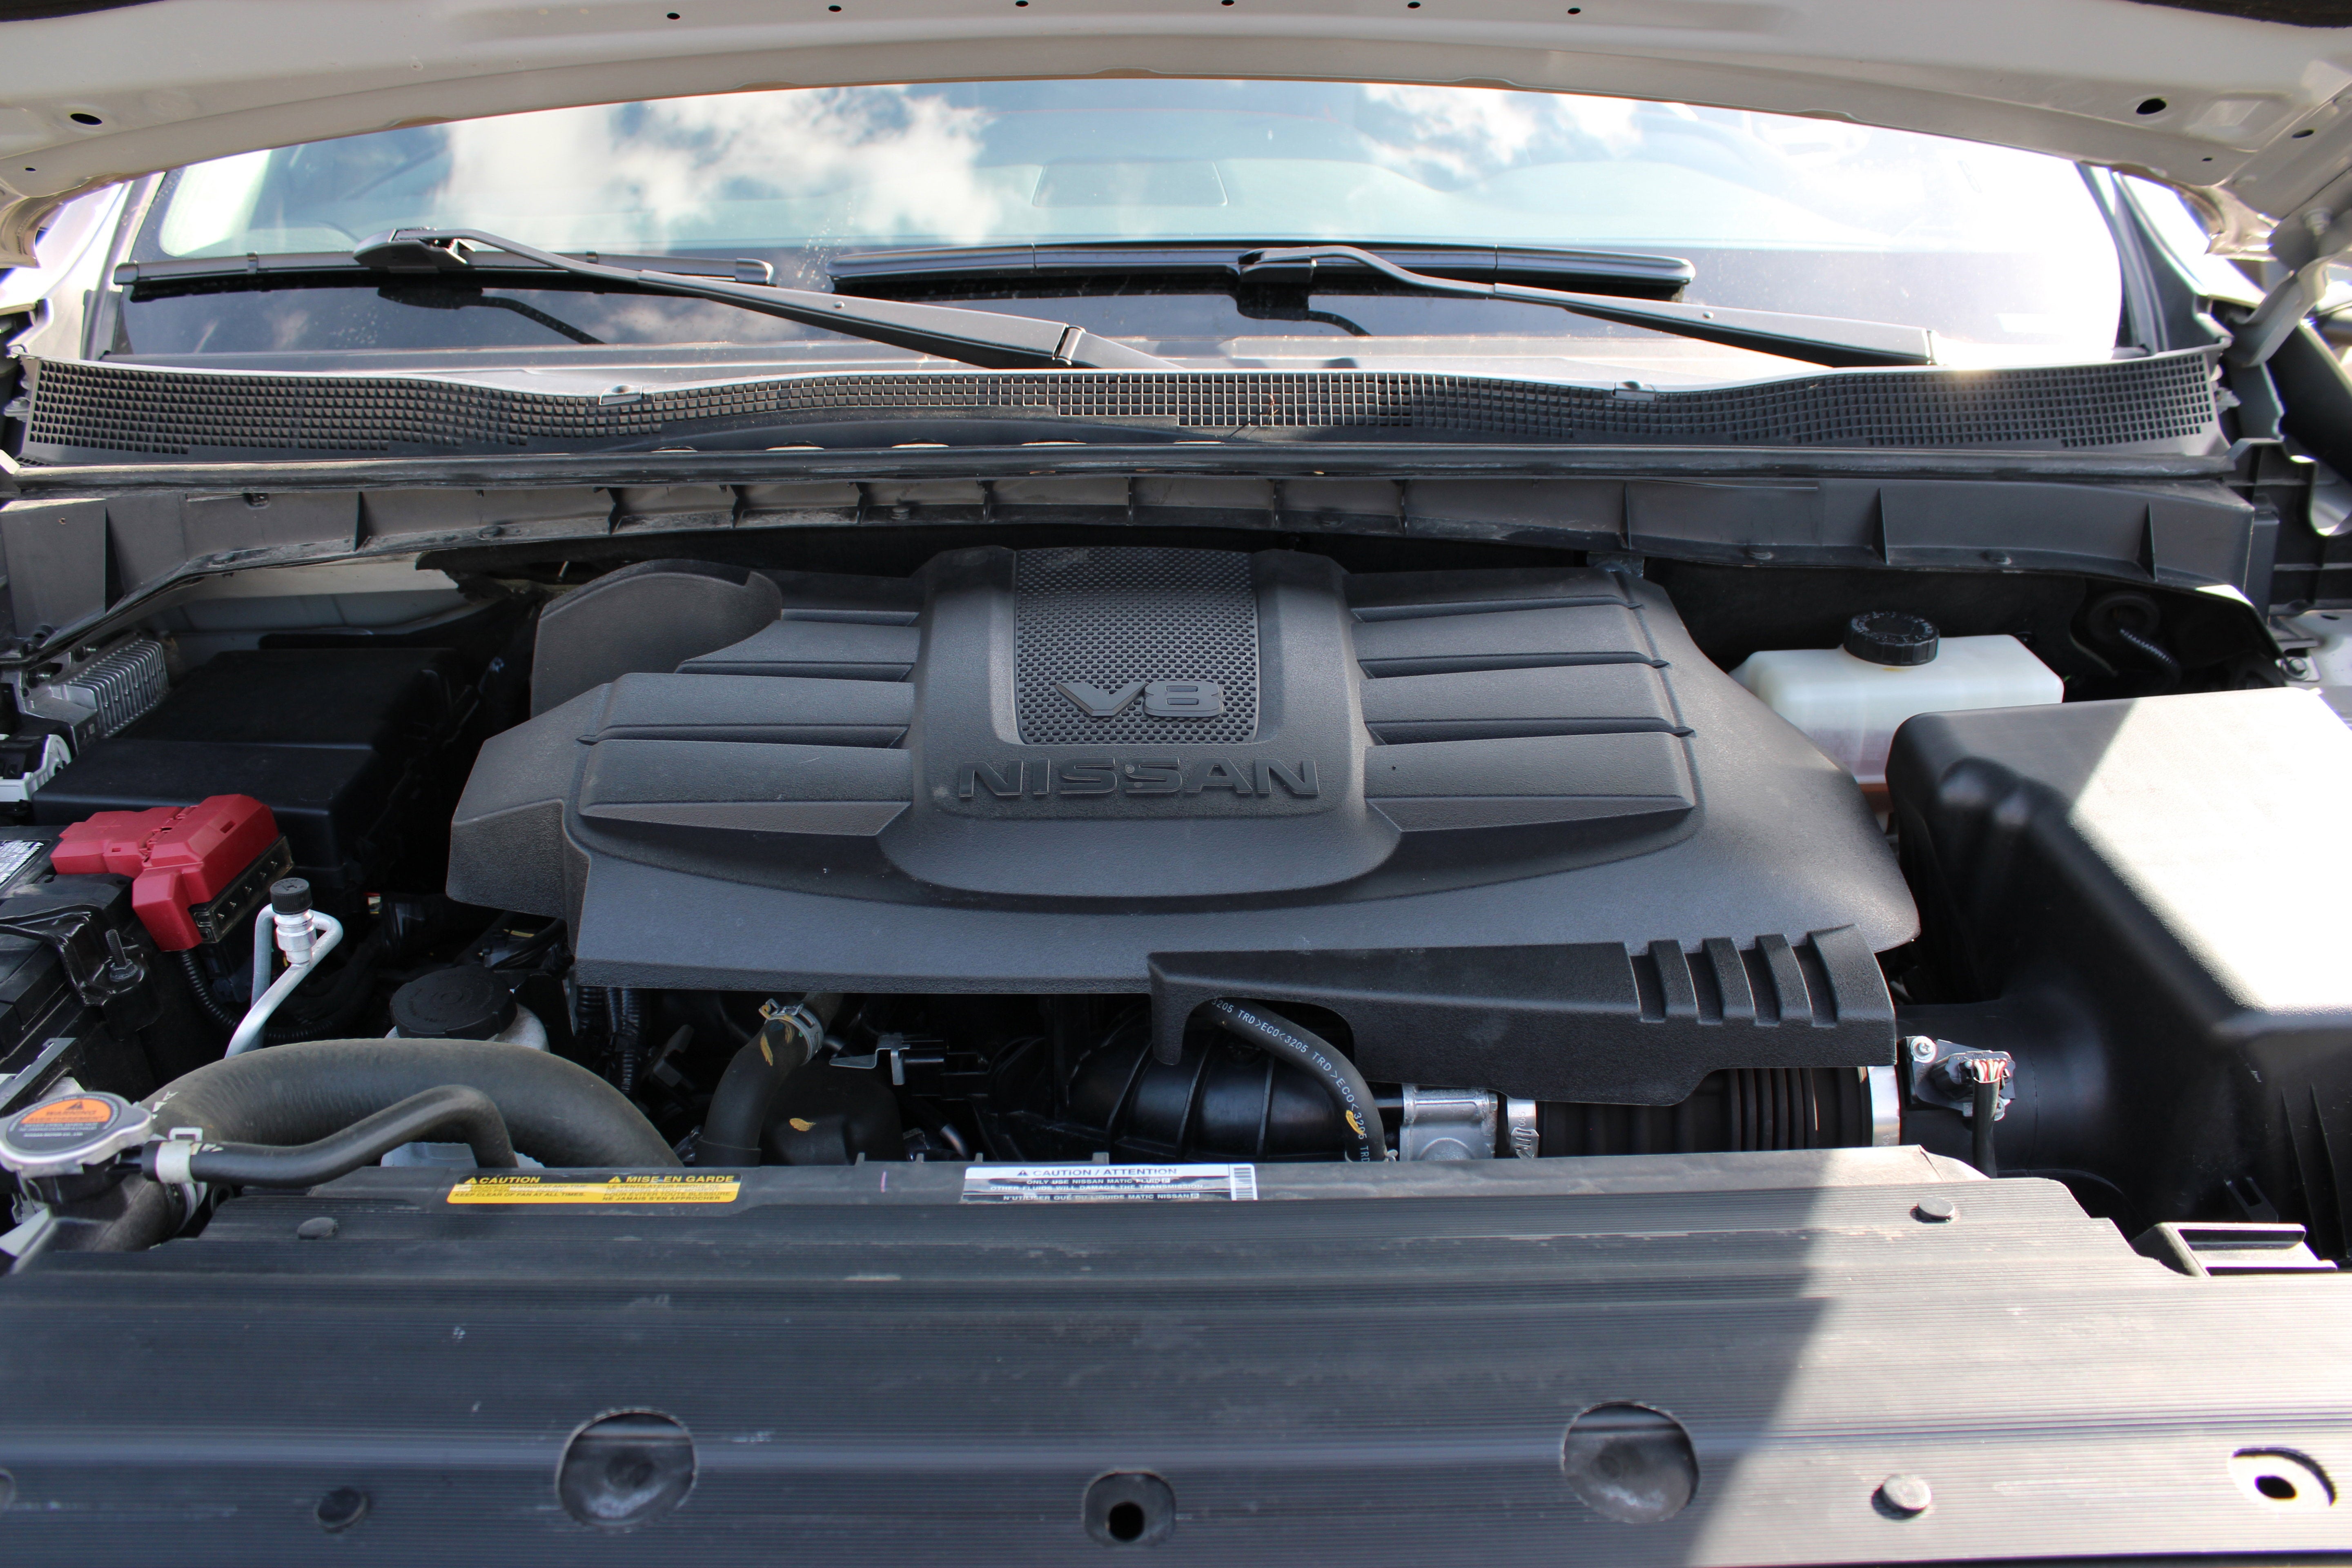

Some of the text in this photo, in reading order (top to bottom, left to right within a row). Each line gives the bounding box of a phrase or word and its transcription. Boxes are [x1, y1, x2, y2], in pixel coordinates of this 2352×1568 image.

[1054, 681, 1225, 717] V8
[958, 757, 1319, 797] NISSAN
[1360, 1145, 1370, 1162] TRD
[479, 1176, 541, 1184] CAUTION
